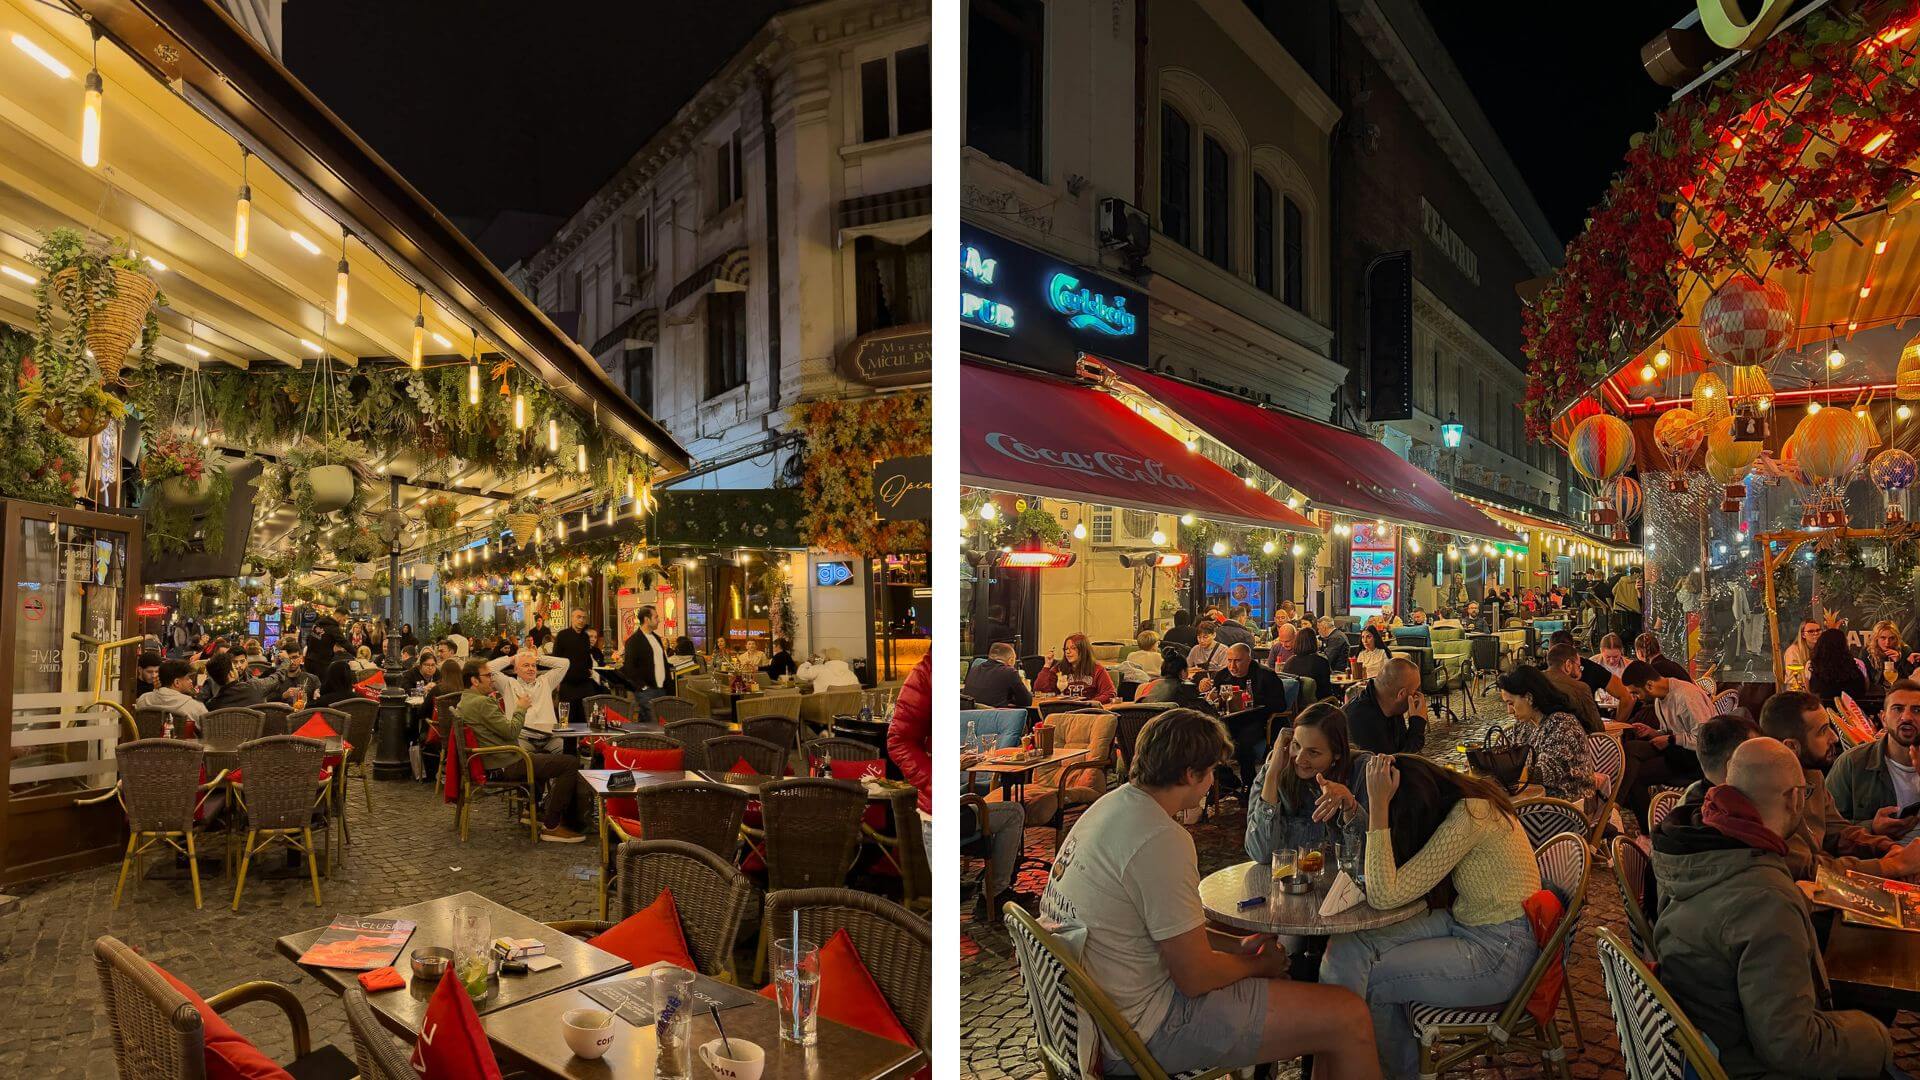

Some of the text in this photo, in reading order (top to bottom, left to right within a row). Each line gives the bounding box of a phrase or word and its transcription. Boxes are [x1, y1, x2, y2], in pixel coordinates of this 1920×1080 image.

[961, 292, 1016, 330] PUB
[1048, 271, 1138, 337] Carlsberg
[984, 431, 1199, 493] Coca-Cola
[819, 563, 848, 585] glo
[710, 1062, 737, 1079] COSTA
